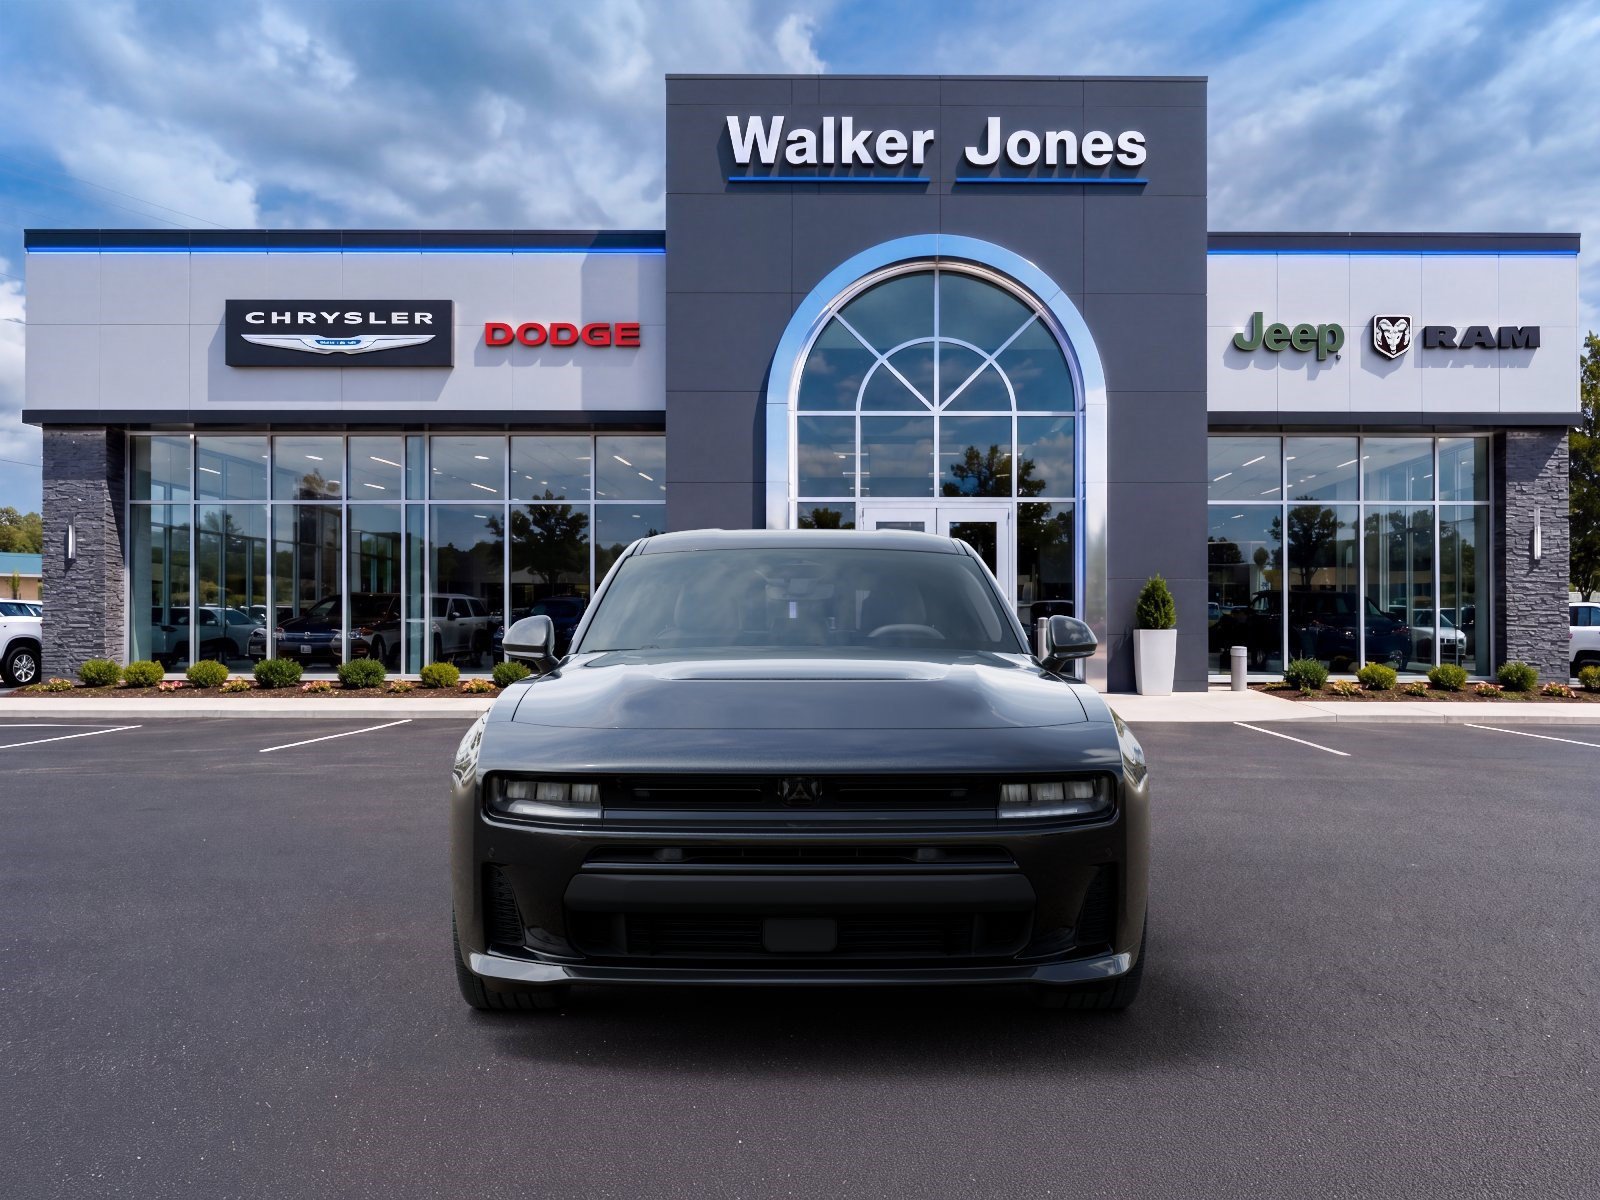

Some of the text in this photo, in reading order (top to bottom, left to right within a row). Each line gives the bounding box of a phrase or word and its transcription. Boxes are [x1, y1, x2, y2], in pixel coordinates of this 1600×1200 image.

[726, 115, 1147, 166] Walker Jones
[245, 311, 434, 325] CHRYSLER
[485, 322, 641, 347] DODGE
[1233, 311, 1345, 361] Jeep
[1423, 325, 1541, 348] RAM
